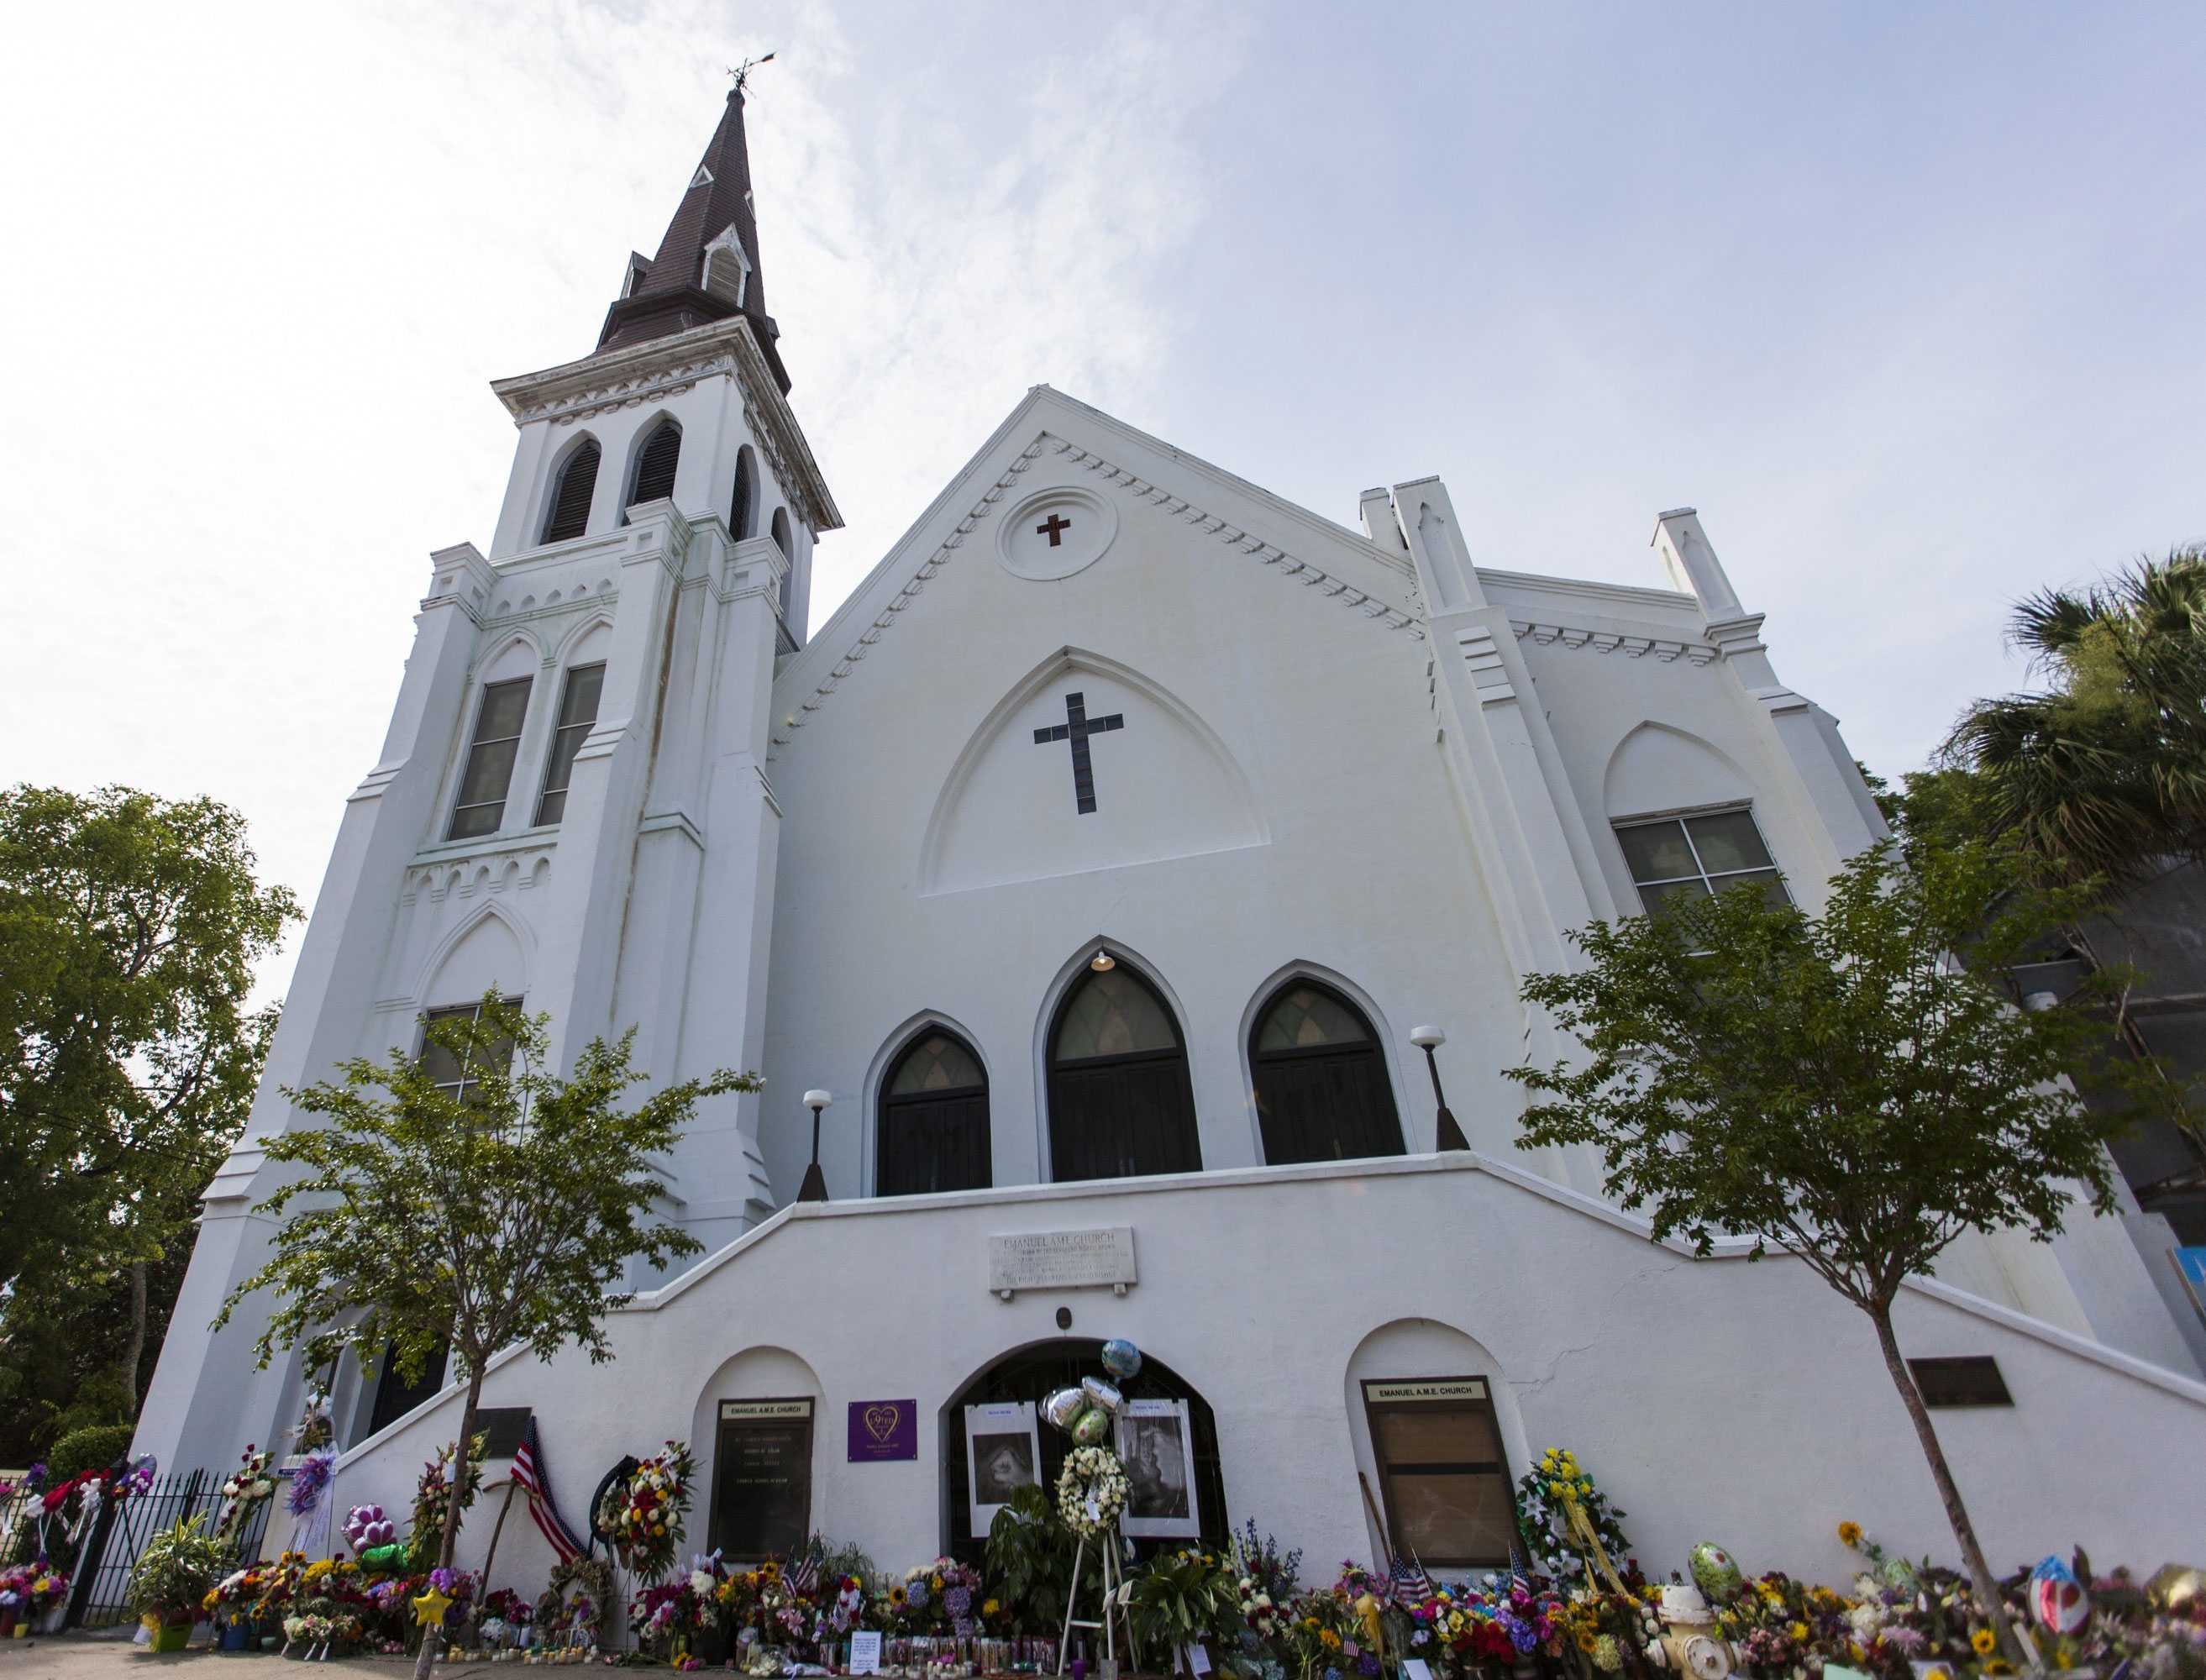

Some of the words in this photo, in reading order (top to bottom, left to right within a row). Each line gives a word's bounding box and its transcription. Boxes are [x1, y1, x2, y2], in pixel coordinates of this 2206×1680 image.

[1073, 1233, 1115, 1246] CHURCH
[1379, 1389, 1416, 1398] EMANUEL
[1416, 1387, 1438, 1396] A.M.E.
[1439, 1386, 1473, 1395] CHURCH
[731, 1406, 758, 1415] EMANUEL
[776, 1404, 801, 1413] CHURCH
